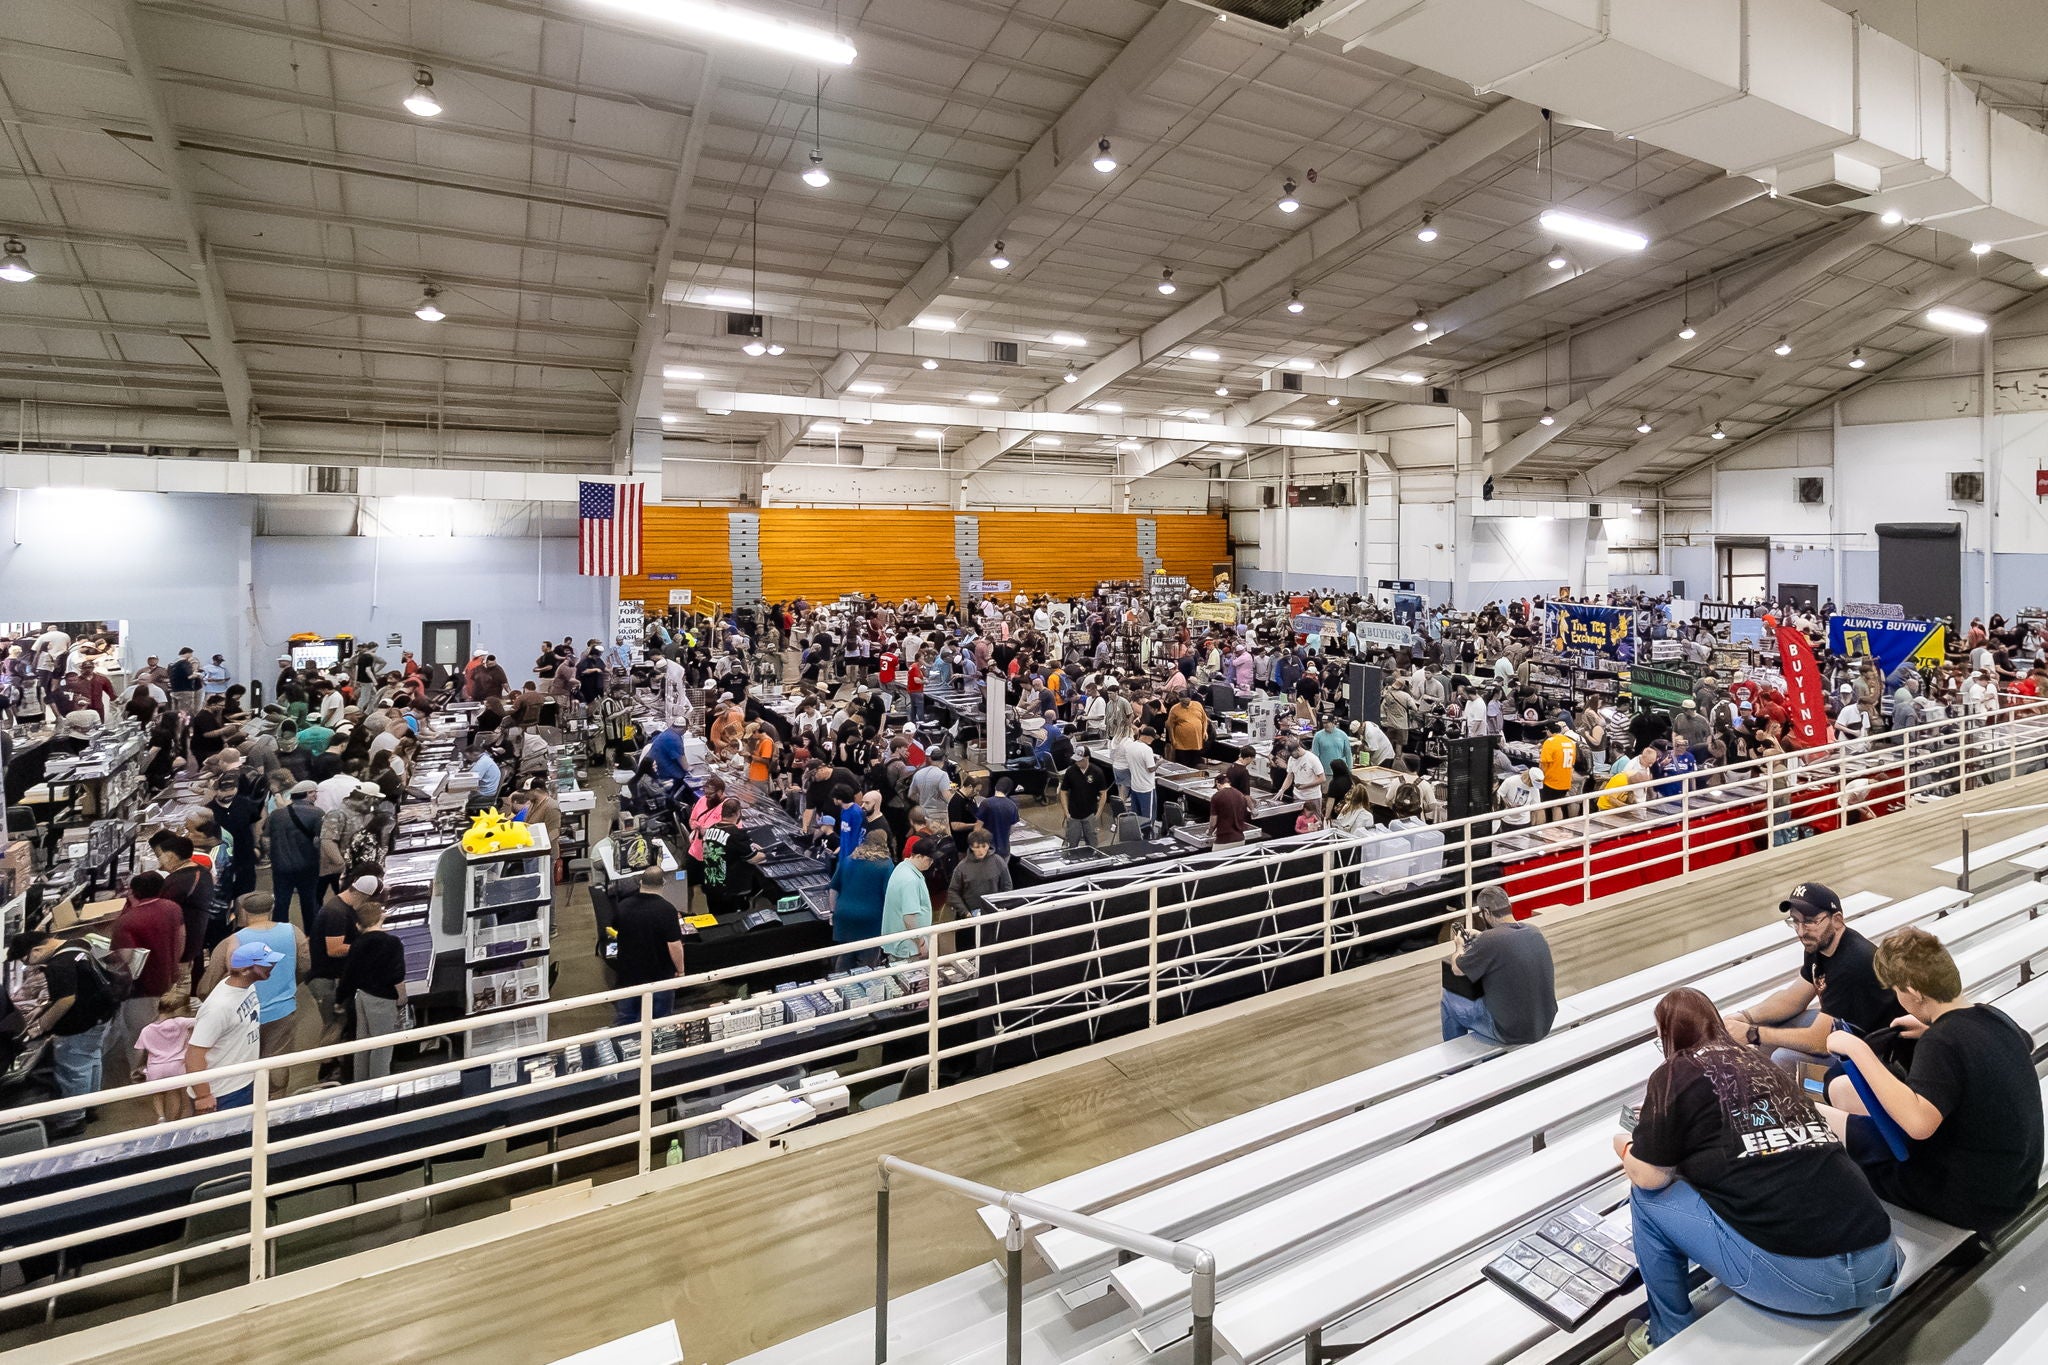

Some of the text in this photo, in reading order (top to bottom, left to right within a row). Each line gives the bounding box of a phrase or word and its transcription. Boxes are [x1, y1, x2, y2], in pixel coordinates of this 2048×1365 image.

[1169, 577, 1186, 585] CARDS
[1702, 606, 1750, 619] BUYING
[619, 616, 643, 624] ARDS
[1843, 618, 1927, 633] ALWAYS BUYING
[1367, 628, 1401, 640] BUYING
[881, 661, 888, 671] 3
[1789, 644, 1814, 737] BUYING
[1563, 748, 1573, 769] 16
[1741, 1123, 1838, 1153] EEVE
